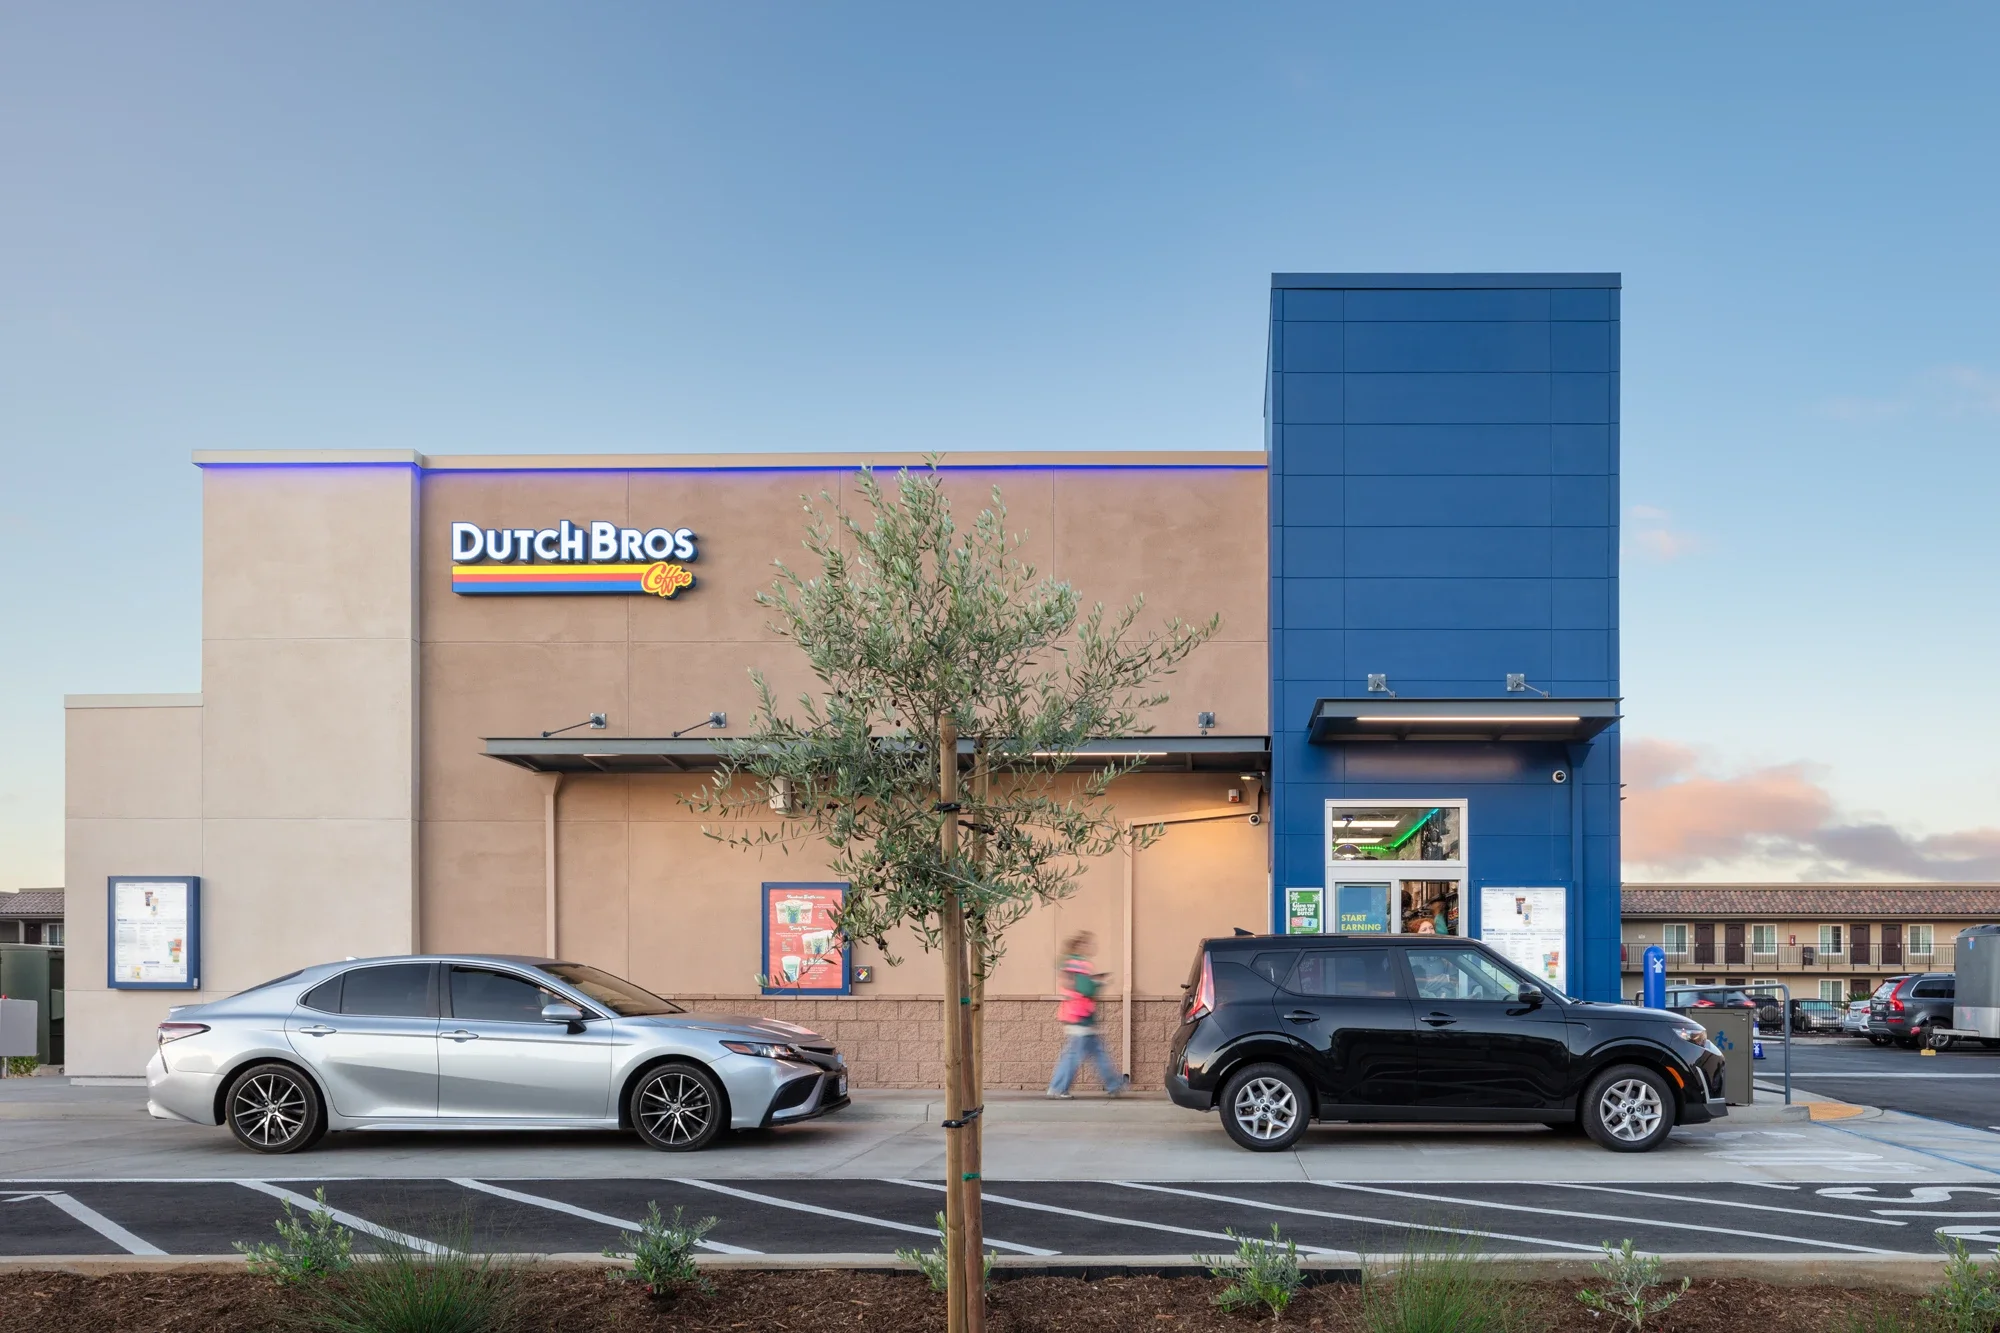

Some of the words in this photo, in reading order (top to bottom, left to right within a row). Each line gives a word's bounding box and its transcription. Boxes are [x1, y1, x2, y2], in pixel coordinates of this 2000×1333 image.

[591, 521, 696, 561] BROS
[642, 562, 692, 595] Coffee
[1341, 923, 1382, 931] EARNING
